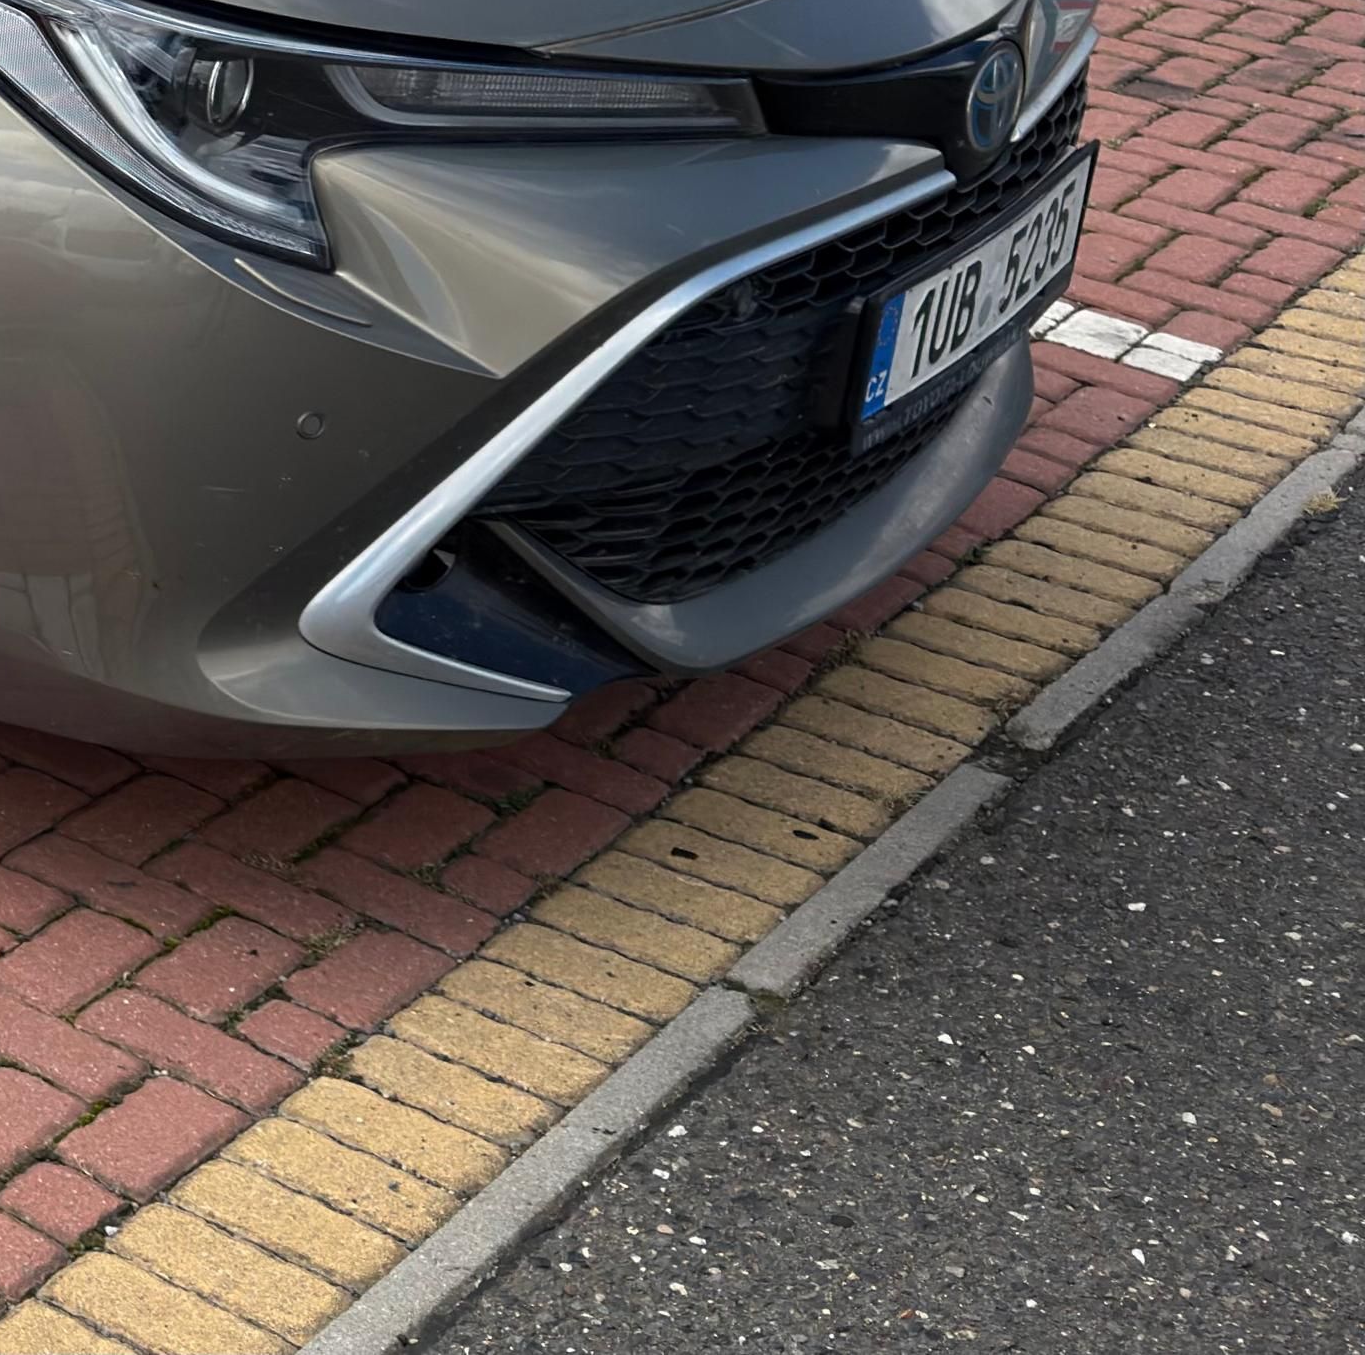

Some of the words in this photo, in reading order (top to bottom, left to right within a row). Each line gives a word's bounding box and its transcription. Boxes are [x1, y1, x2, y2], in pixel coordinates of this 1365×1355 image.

[911, 260, 983, 379] 1UB
[998, 180, 1077, 315] 5235
[865, 369, 888, 403] CZ
